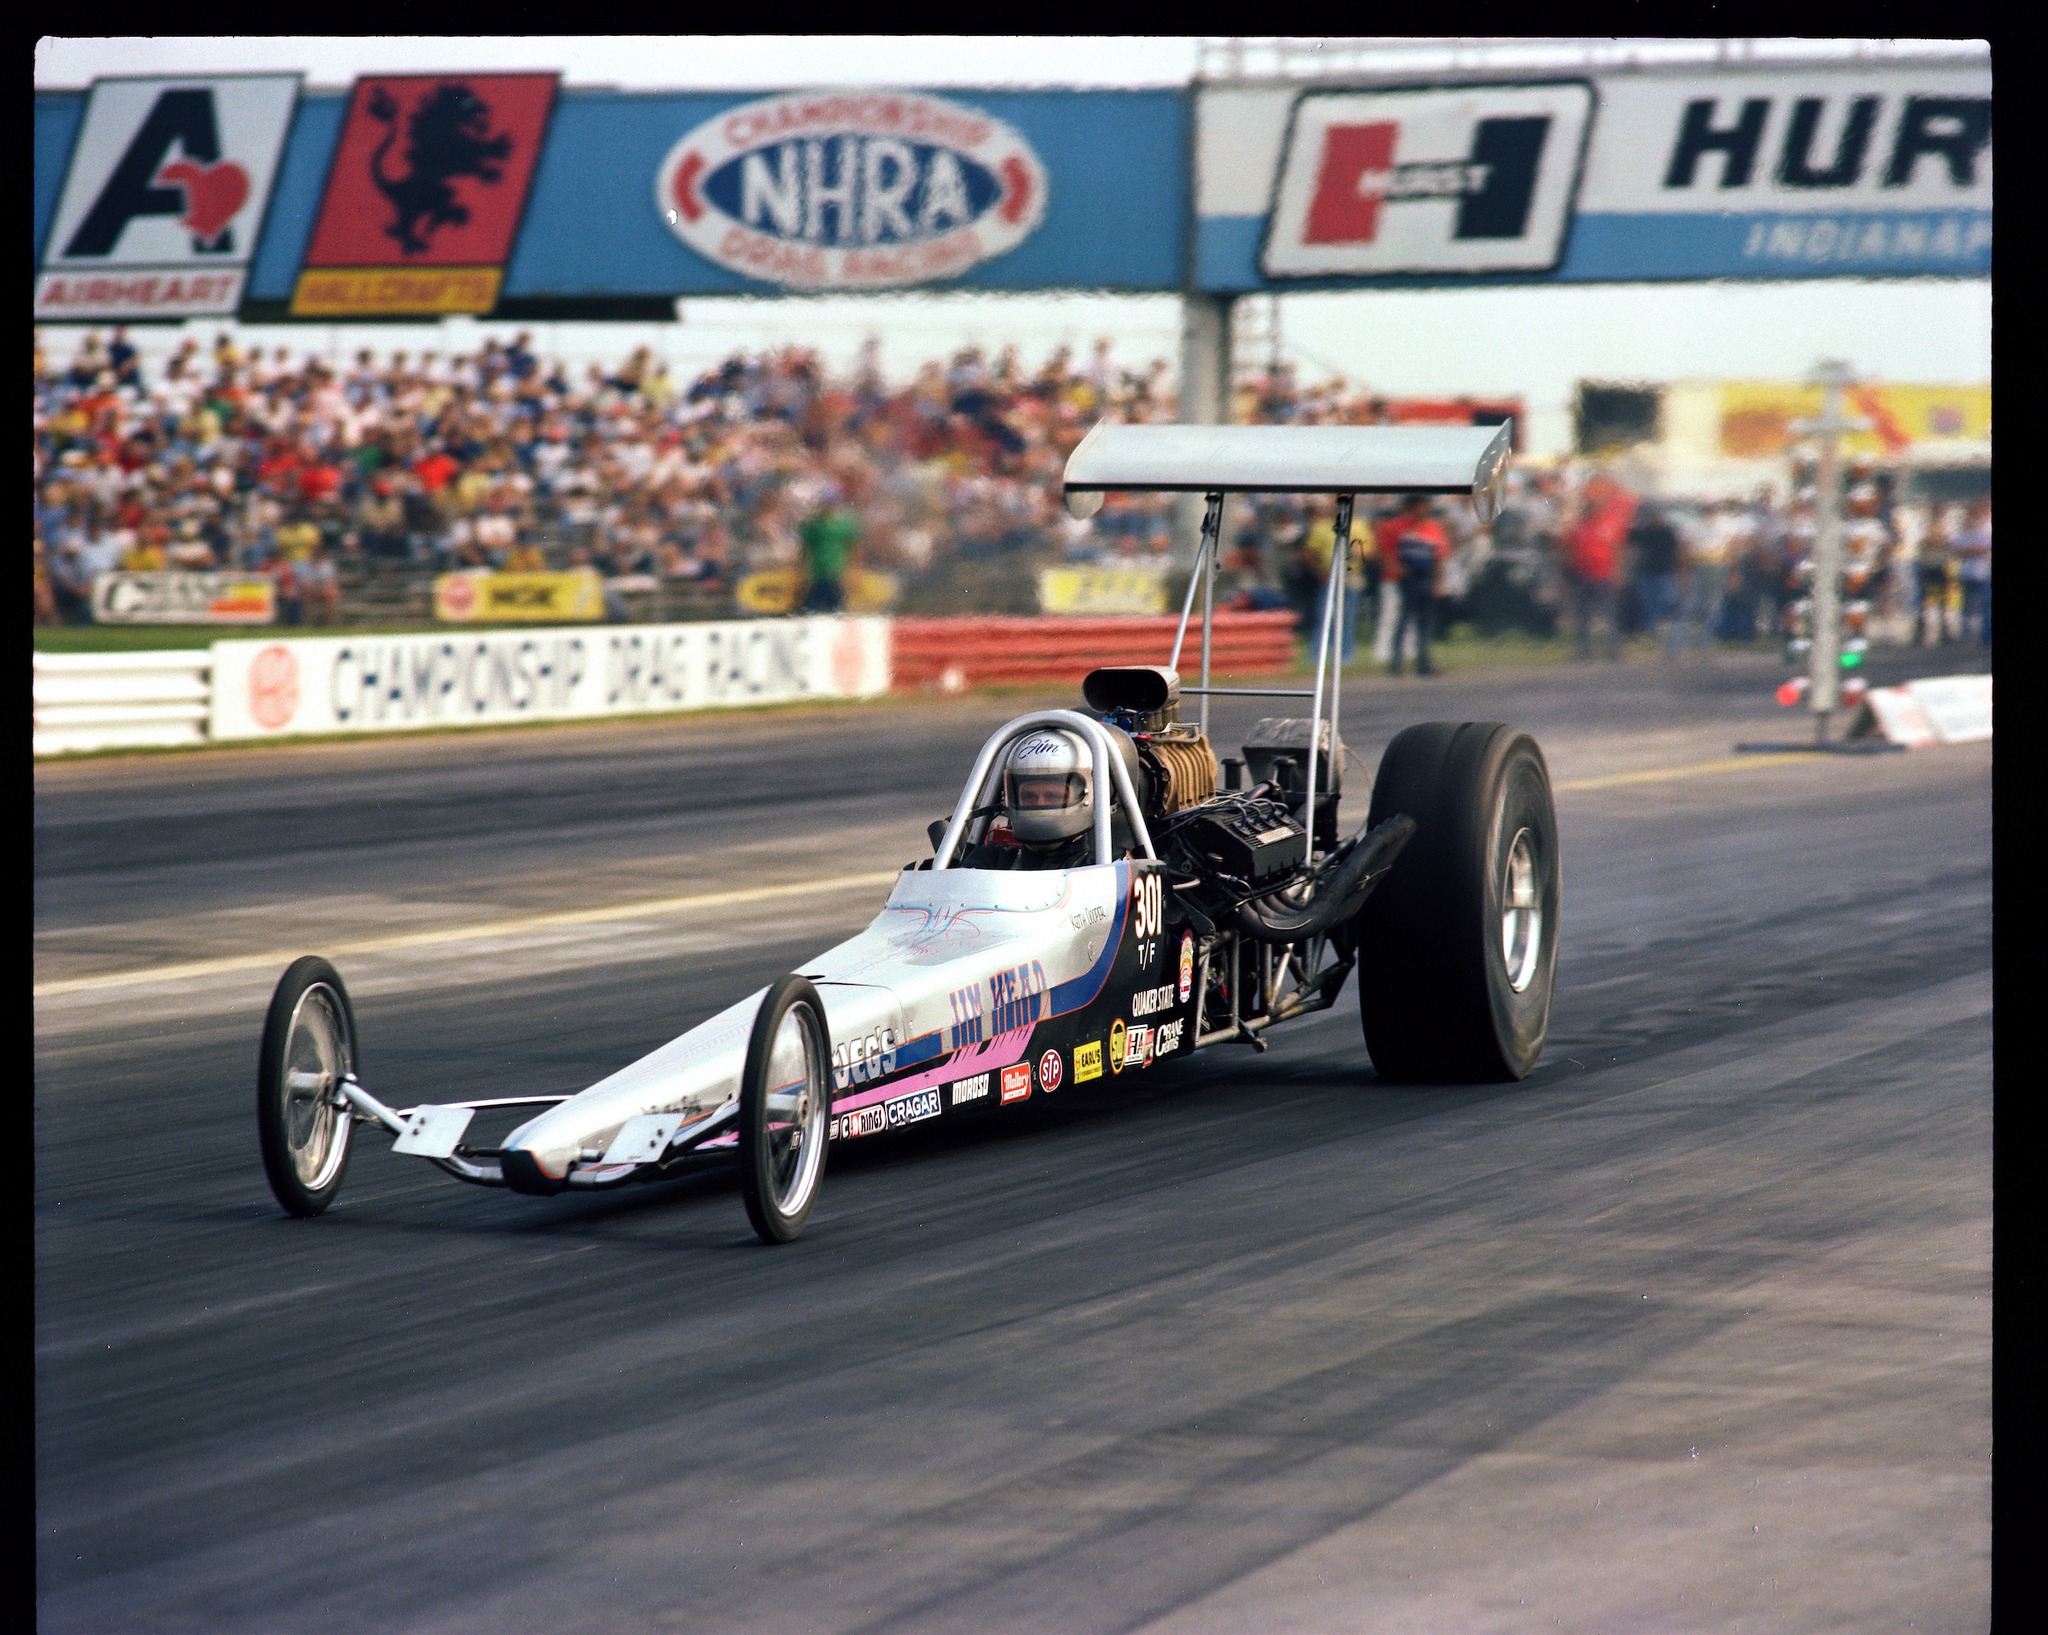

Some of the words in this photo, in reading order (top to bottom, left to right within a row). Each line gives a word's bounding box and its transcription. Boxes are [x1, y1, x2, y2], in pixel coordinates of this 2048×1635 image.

[1662, 95, 1992, 188] HUR
[740, 138, 968, 244] NHRA
[42, 275, 236, 306] AIRHEART
[328, 637, 590, 721] CHAMPIONSHIP
[603, 634, 689, 705] DRAG
[1134, 872, 1162, 938] 301
[1138, 938, 1156, 971] T/F
[1132, 988, 1158, 1018] QUAKER
[1157, 983, 1175, 1012] STATE
[1042, 1054, 1060, 1084] STP
[1081, 1049, 1100, 1068] EARL'S
[952, 1072, 990, 1105] MOROSO
[1004, 1071, 1029, 1091] Mallory
[860, 1109, 883, 1132] RINGS
[888, 1092, 938, 1124] CRAGAR
